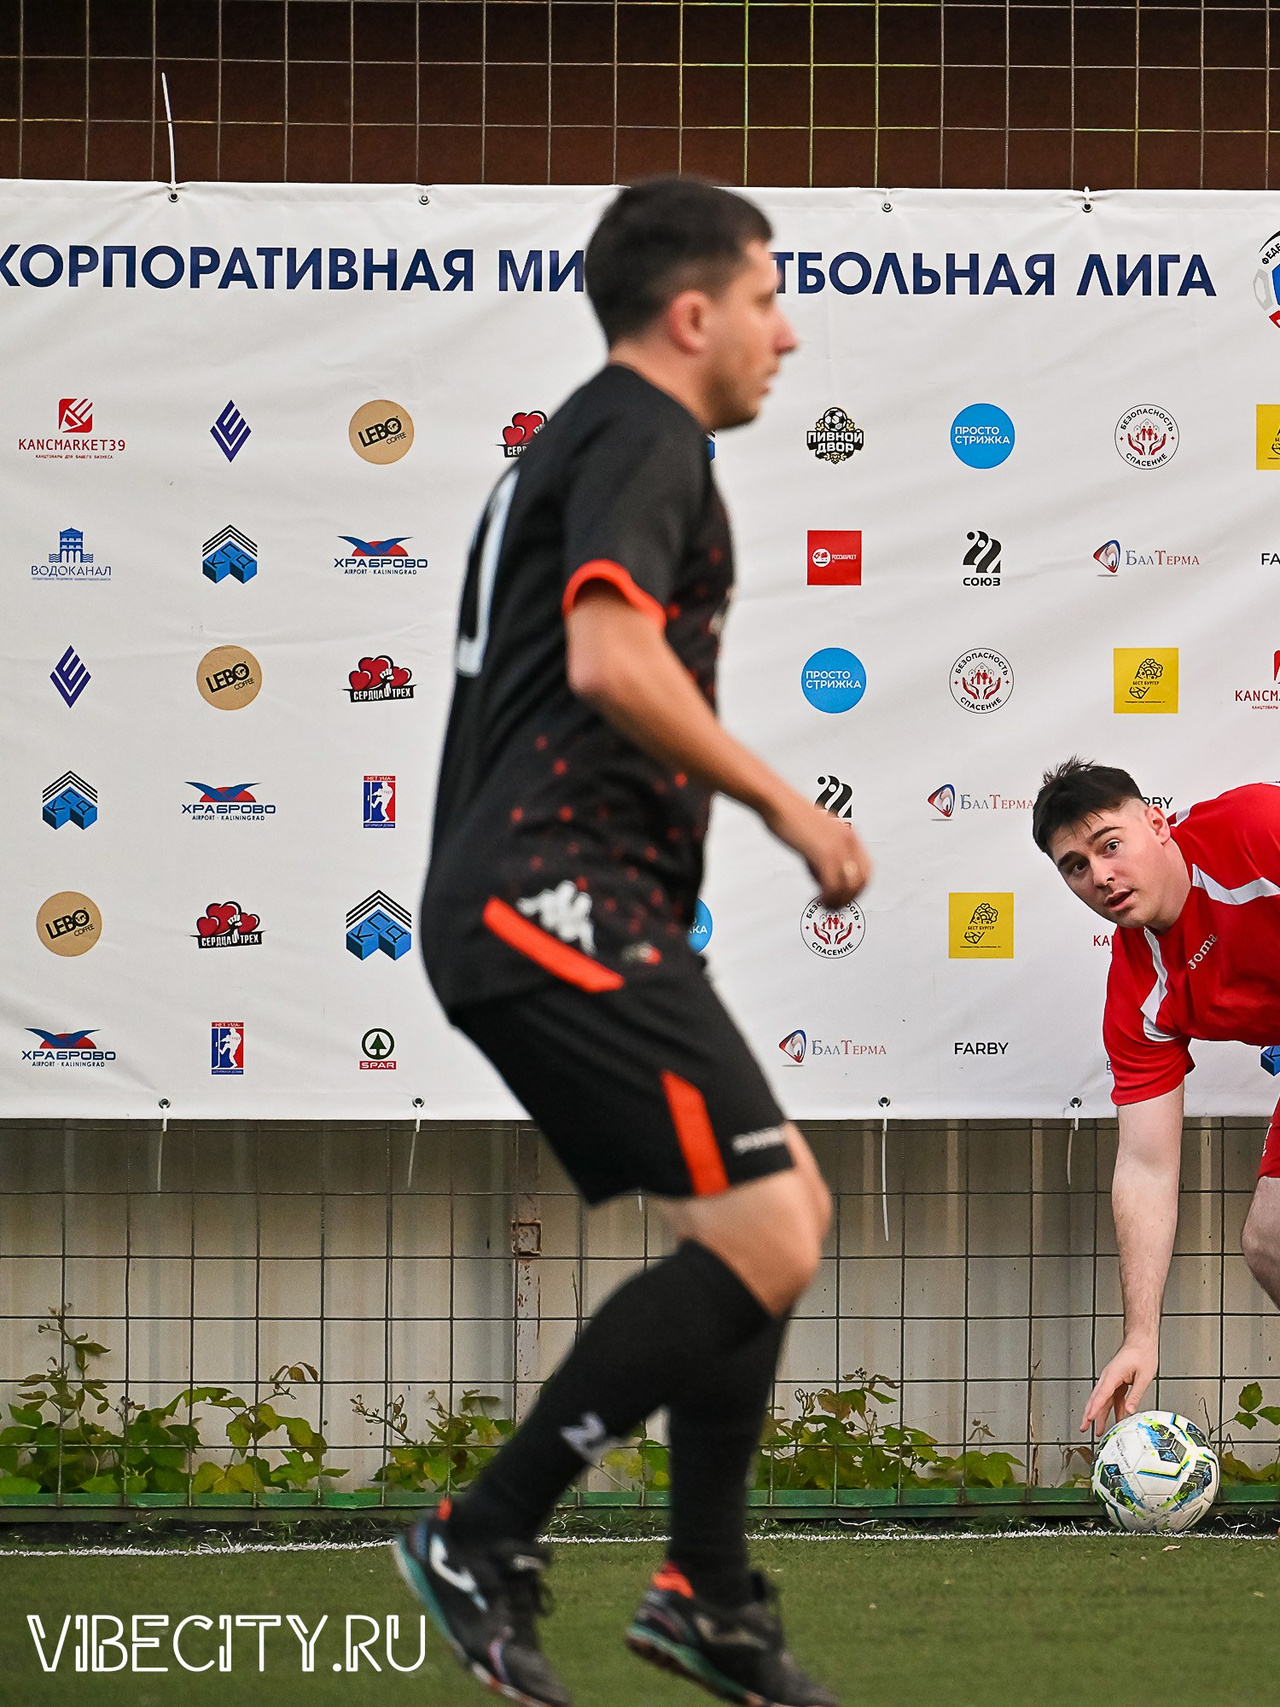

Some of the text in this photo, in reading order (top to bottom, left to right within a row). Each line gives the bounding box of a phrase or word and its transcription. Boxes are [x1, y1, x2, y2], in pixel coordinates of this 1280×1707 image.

[1076, 253, 1217, 297] ЛИГА
[1120, 408, 1174, 432] БЕЗОПАСНОСТЬ
[358, 416, 403, 448] LEBO
[807, 429, 864, 444] ПИВНОЙ
[955, 427, 1000, 435] ПРОСТО
[18, 438, 126, 451] KANCMARKET39
[385, 432, 407, 446] COFFEE
[955, 435, 1011, 446] СТРИЖКА
[816, 442, 855, 454] ДВОР
[1126, 452, 1168, 467] СПАСЕНИЕ
[334, 558, 428, 568] ХРАБРОВО
[31, 565, 112, 577] ВОДОКАНАЛ
[962, 577, 1001, 587] СОЮЗ
[955, 652, 1009, 676] БЕЗОПАСНОСТЬ
[205, 662, 250, 694] LEBO
[806, 671, 850, 679] ПРОСТО
[233, 677, 255, 691] COFFEE
[806, 680, 862, 690] СТРИЖКА
[353, 687, 411, 701] СЕРДЦА ТРЕХ
[960, 696, 1002, 711] СПАСЕНИЕ
[182, 804, 276, 814] ХРАБРОВО
[806, 901, 860, 921] БЕЗООСТЬ
[45, 908, 90, 940] LEBO
[73, 923, 95, 937] COFFEE
[201, 934, 259, 947] СЕРДЦА ТРЕХ
[811, 941, 854, 956] СПАСЕНИЕ
[22, 1050, 116, 1061] ХРАБРОВО
[954, 1042, 1009, 1055] FARBY
